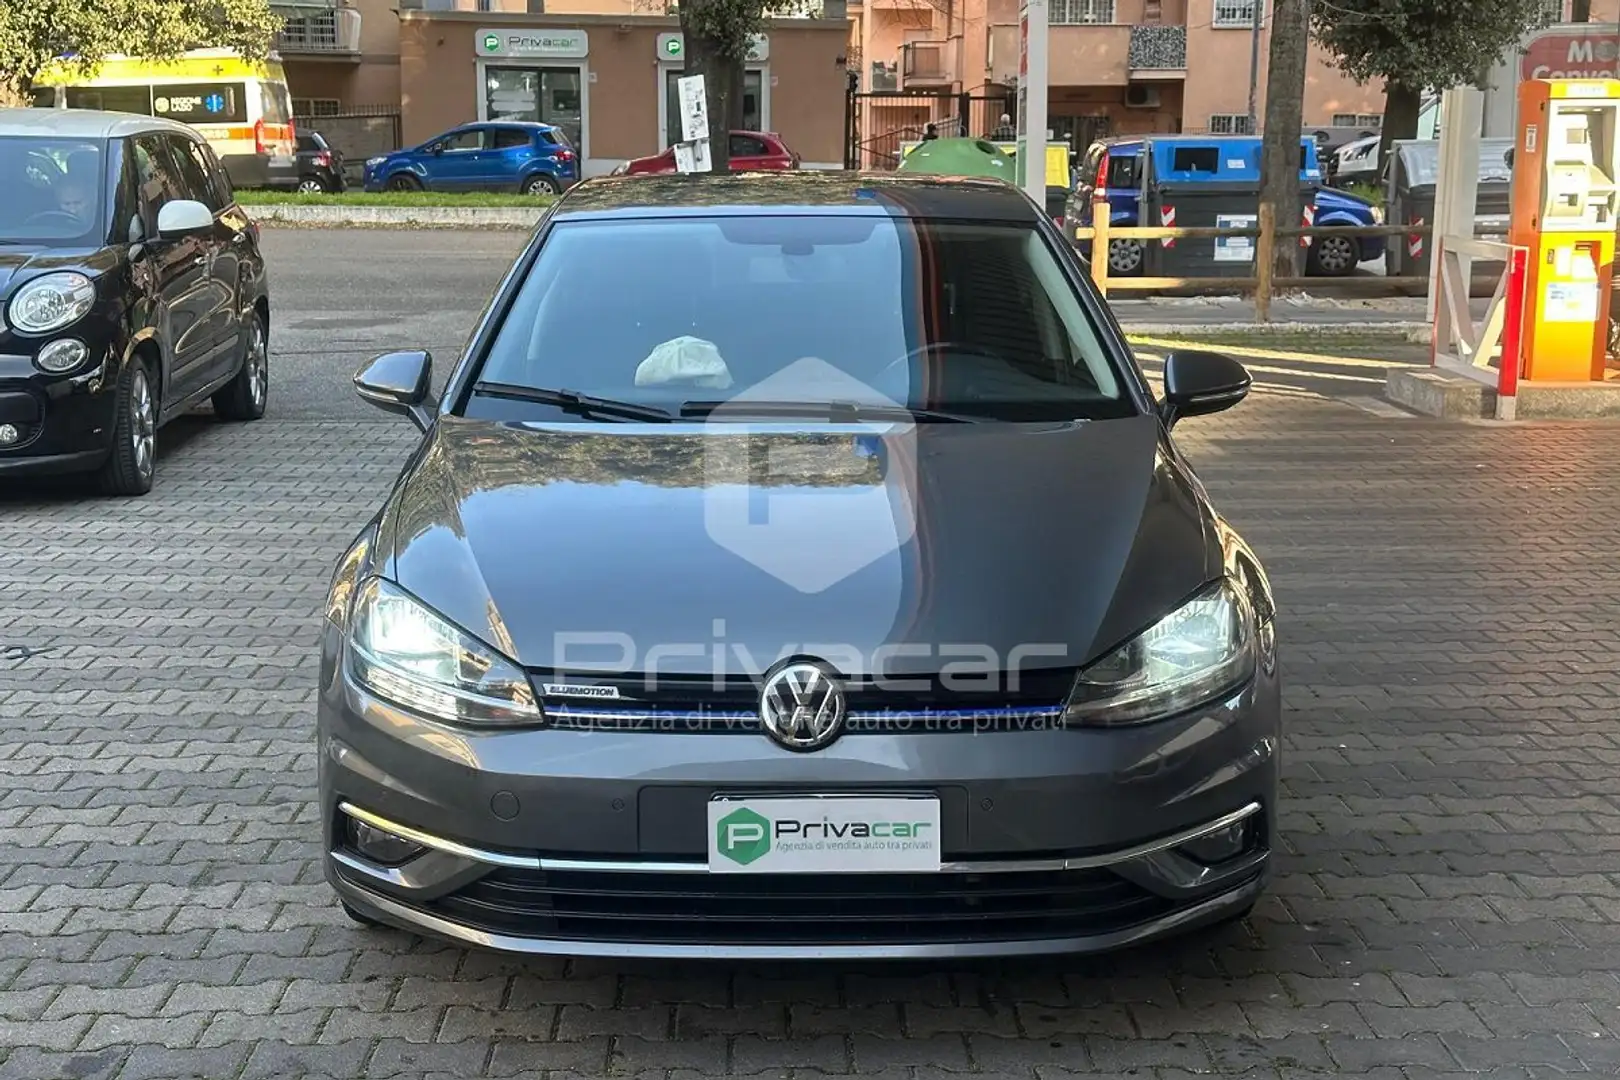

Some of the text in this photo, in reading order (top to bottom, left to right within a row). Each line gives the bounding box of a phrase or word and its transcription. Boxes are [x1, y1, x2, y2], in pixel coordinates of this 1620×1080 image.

[508, 36, 579, 47] Privacar
[549, 686, 614, 696] BLUEMOTION
[775, 816, 932, 838] Privacar
[775, 841, 932, 854] Agenzia di vendita auto tra privati
